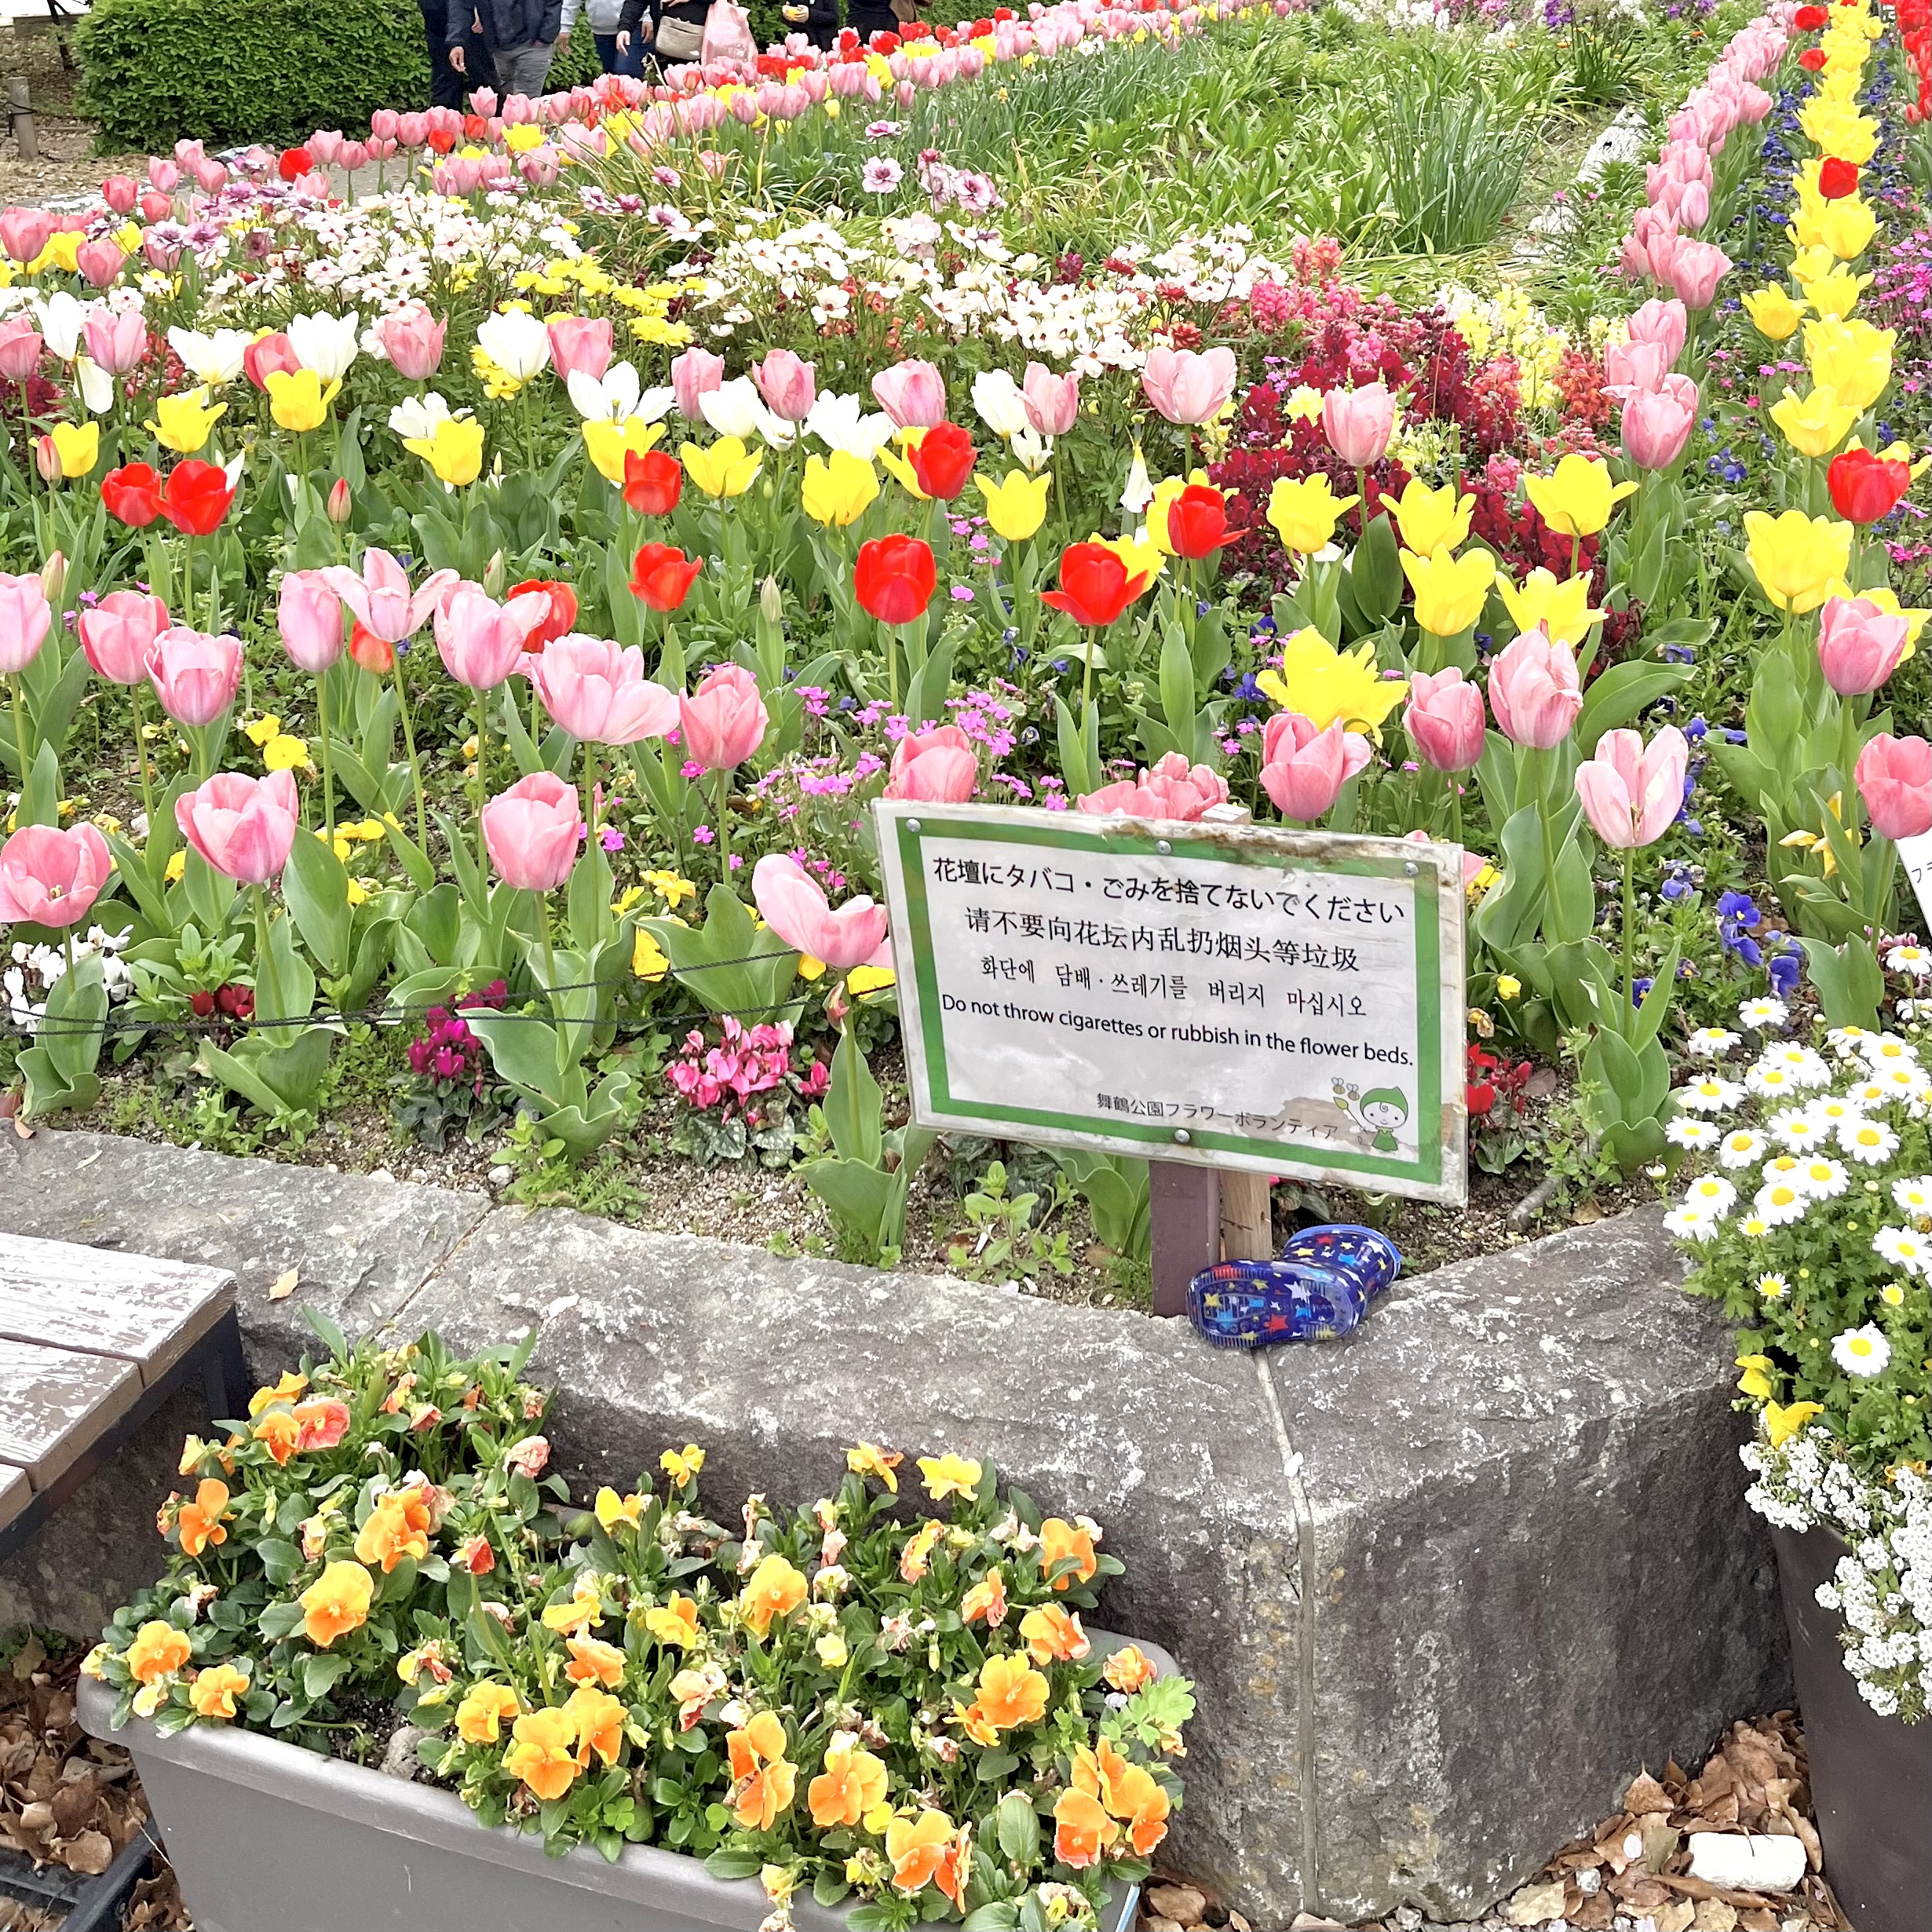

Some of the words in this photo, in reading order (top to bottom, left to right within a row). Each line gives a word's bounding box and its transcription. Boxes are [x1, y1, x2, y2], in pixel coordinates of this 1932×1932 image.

[933, 856, 1405, 924] 花壇にタバコ・ごみを捨てないでください
[965, 906, 1360, 973] 请不要向花坛内乱扔烟头等垃圾
[981, 955, 1035, 984] 화단에
[1208, 981, 1265, 1009] 버리지
[1286, 988, 1368, 1018] 마십시오
[942, 994, 966, 1012] Do
[971, 1000, 1000, 1017] not
[1003, 1003, 1054, 1024] throw
[1059, 1010, 1143, 1037] cigarettes
[1148, 1024, 1167, 1039] or
[1171, 1024, 1240, 1045] rubbish
[1244, 1029, 1262, 1046] in
[1265, 1033, 1296, 1053] the
[1301, 1037, 1359, 1058] flower
[1364, 1043, 1414, 1066] beds.
[1097, 1093, 1339, 1139] 舞鶴公園フラワーボランティア
